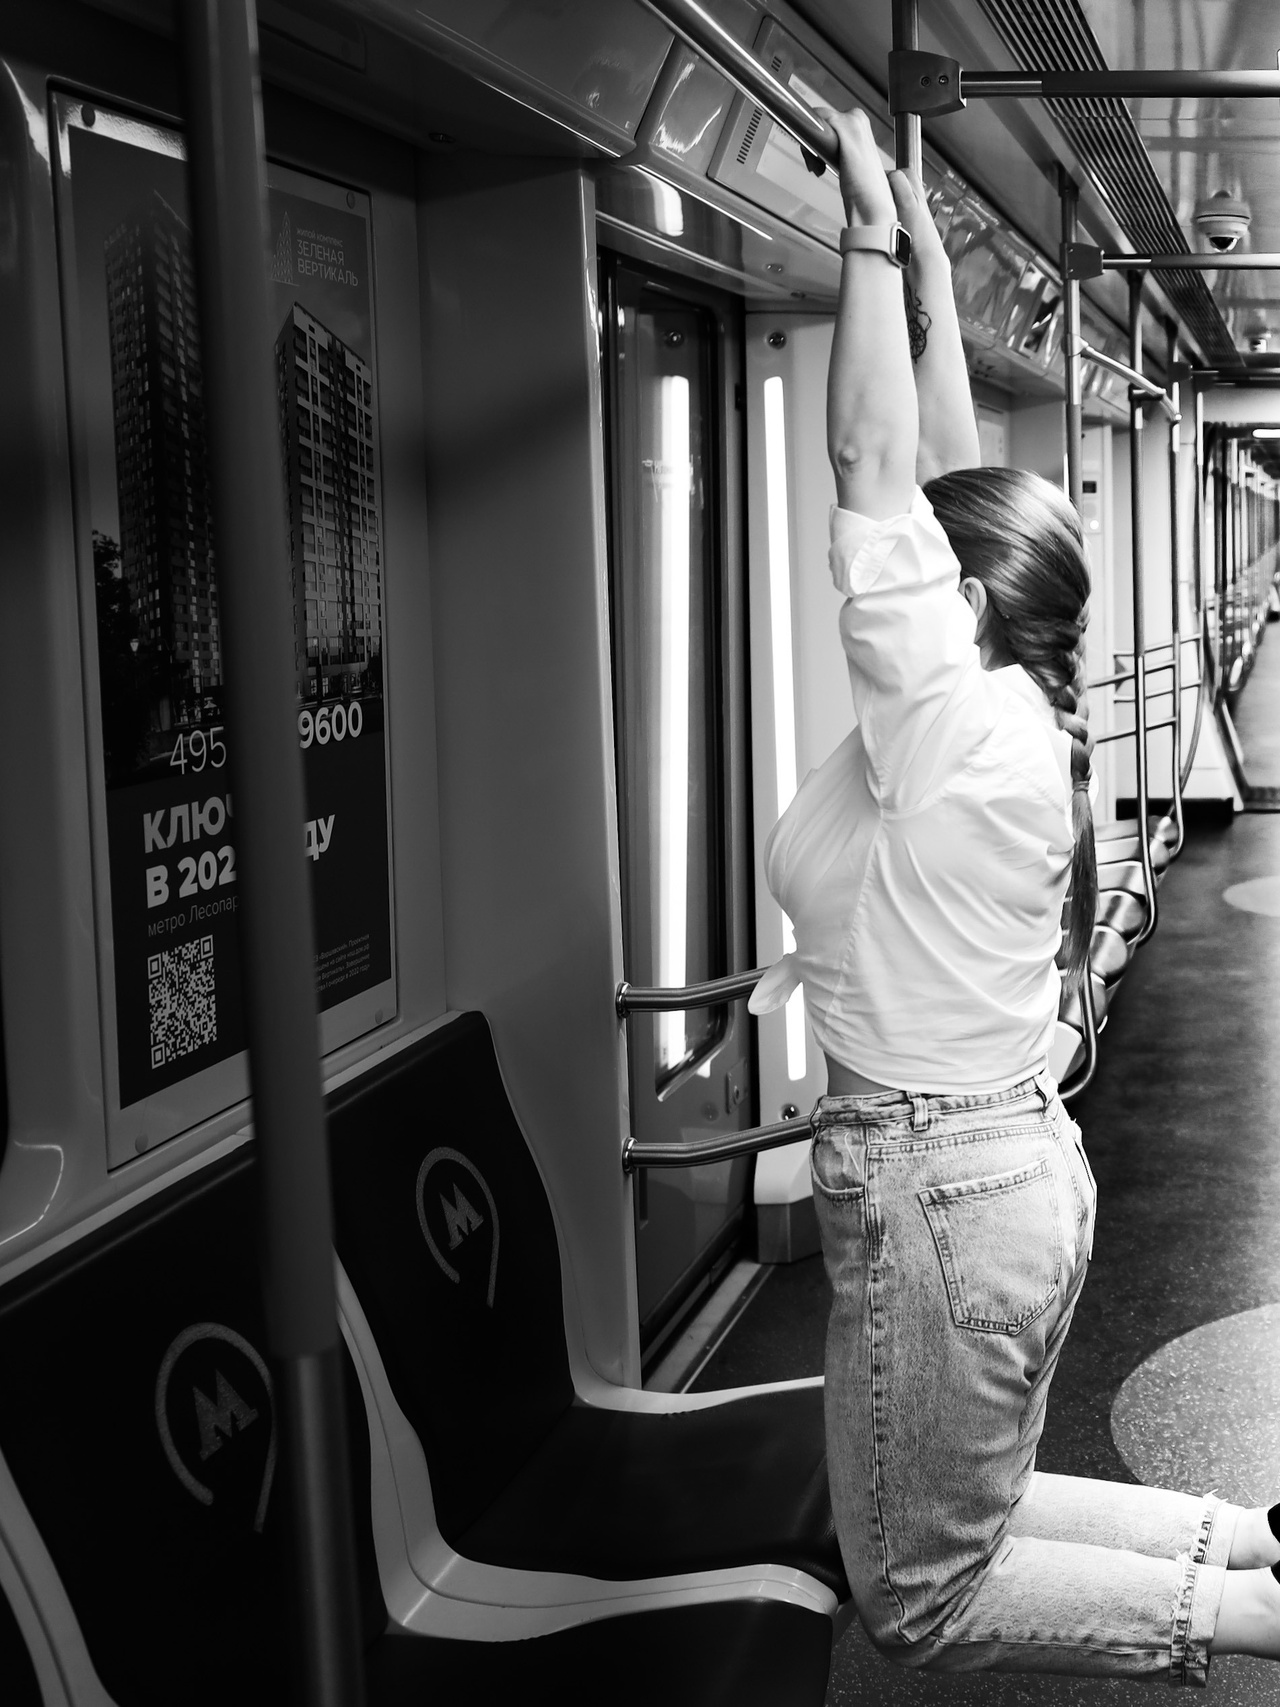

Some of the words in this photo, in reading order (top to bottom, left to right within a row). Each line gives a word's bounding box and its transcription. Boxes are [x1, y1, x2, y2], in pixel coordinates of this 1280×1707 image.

[297, 239, 344, 265] ЗЕЛЕНАЯ
[298, 258, 358, 286] ВЕРТИКАЛЬ
[170, 726, 227, 775] 495
[297, 701, 363, 749] 9600
[146, 864, 170, 909] В
[148, 913, 186, 937] метро
